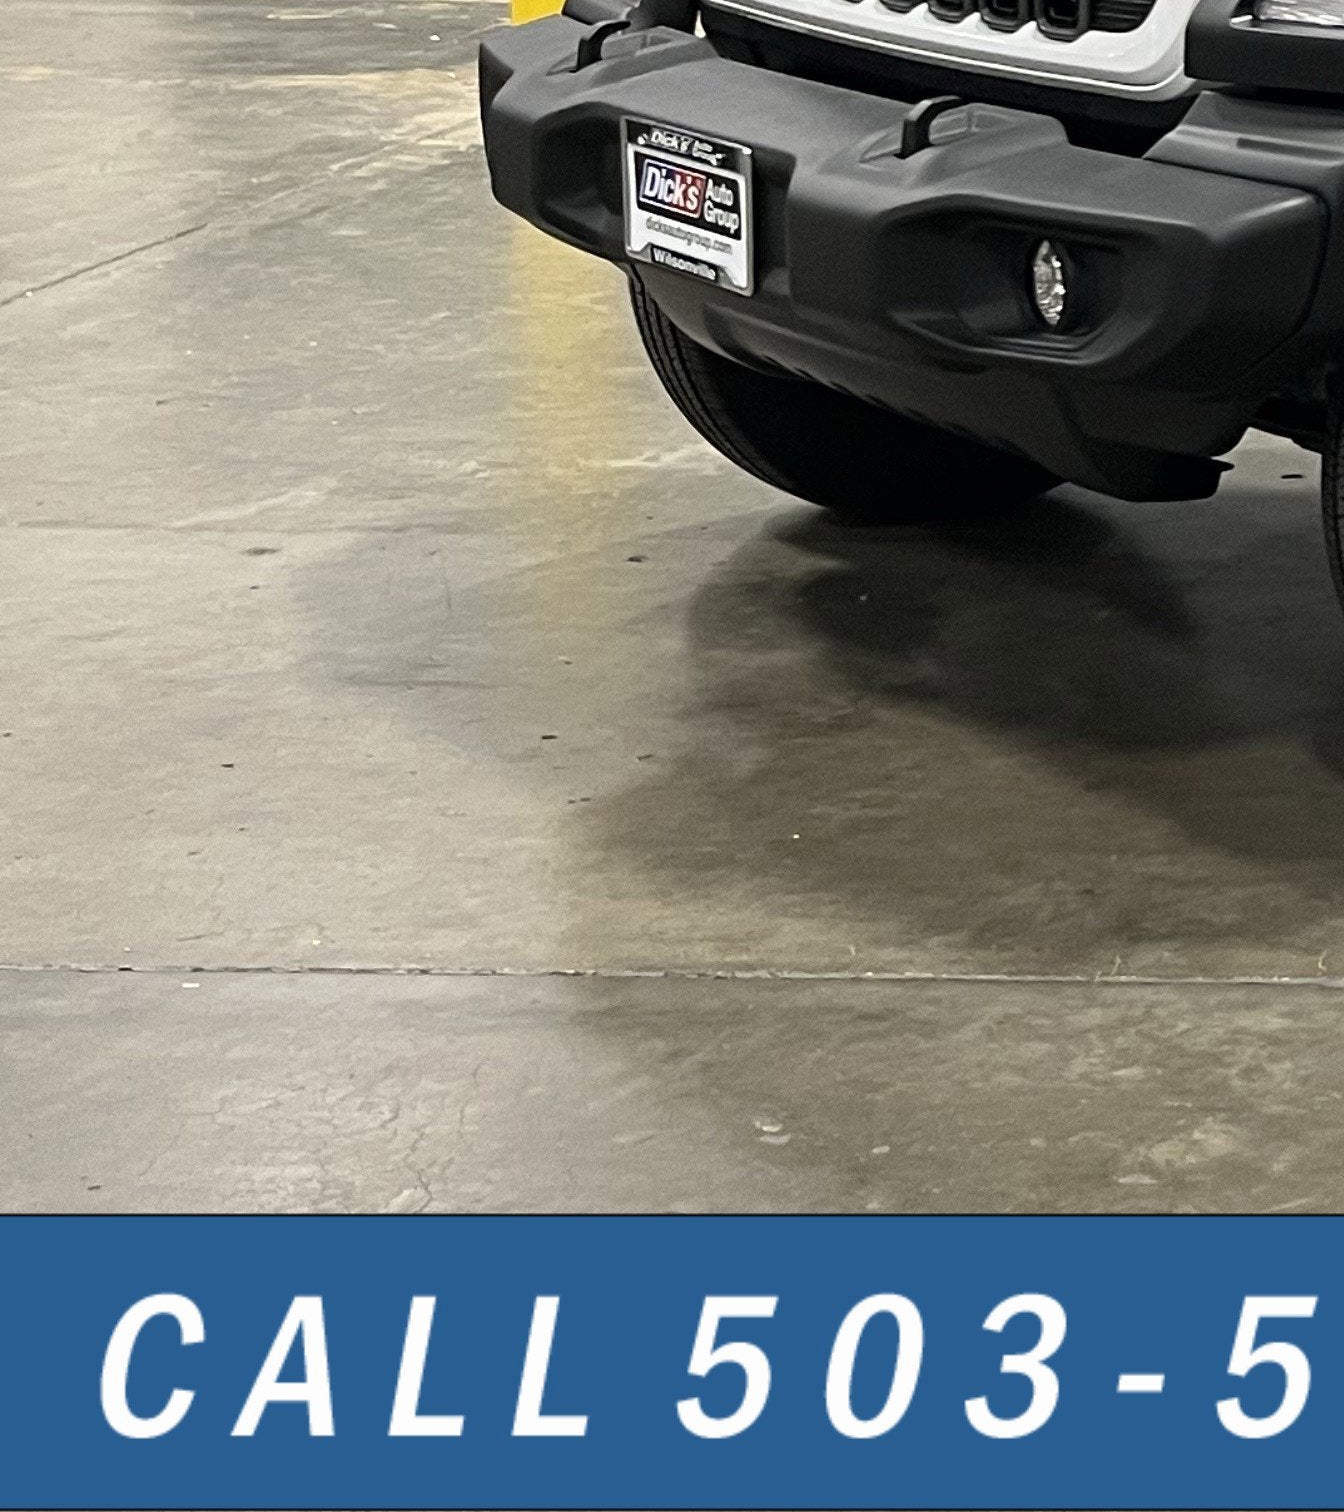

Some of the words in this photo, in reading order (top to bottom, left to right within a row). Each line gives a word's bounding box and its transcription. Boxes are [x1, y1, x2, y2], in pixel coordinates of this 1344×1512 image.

[644, 166, 700, 211] Dick's
[705, 178, 734, 207] Auto
[703, 199, 740, 235] Group
